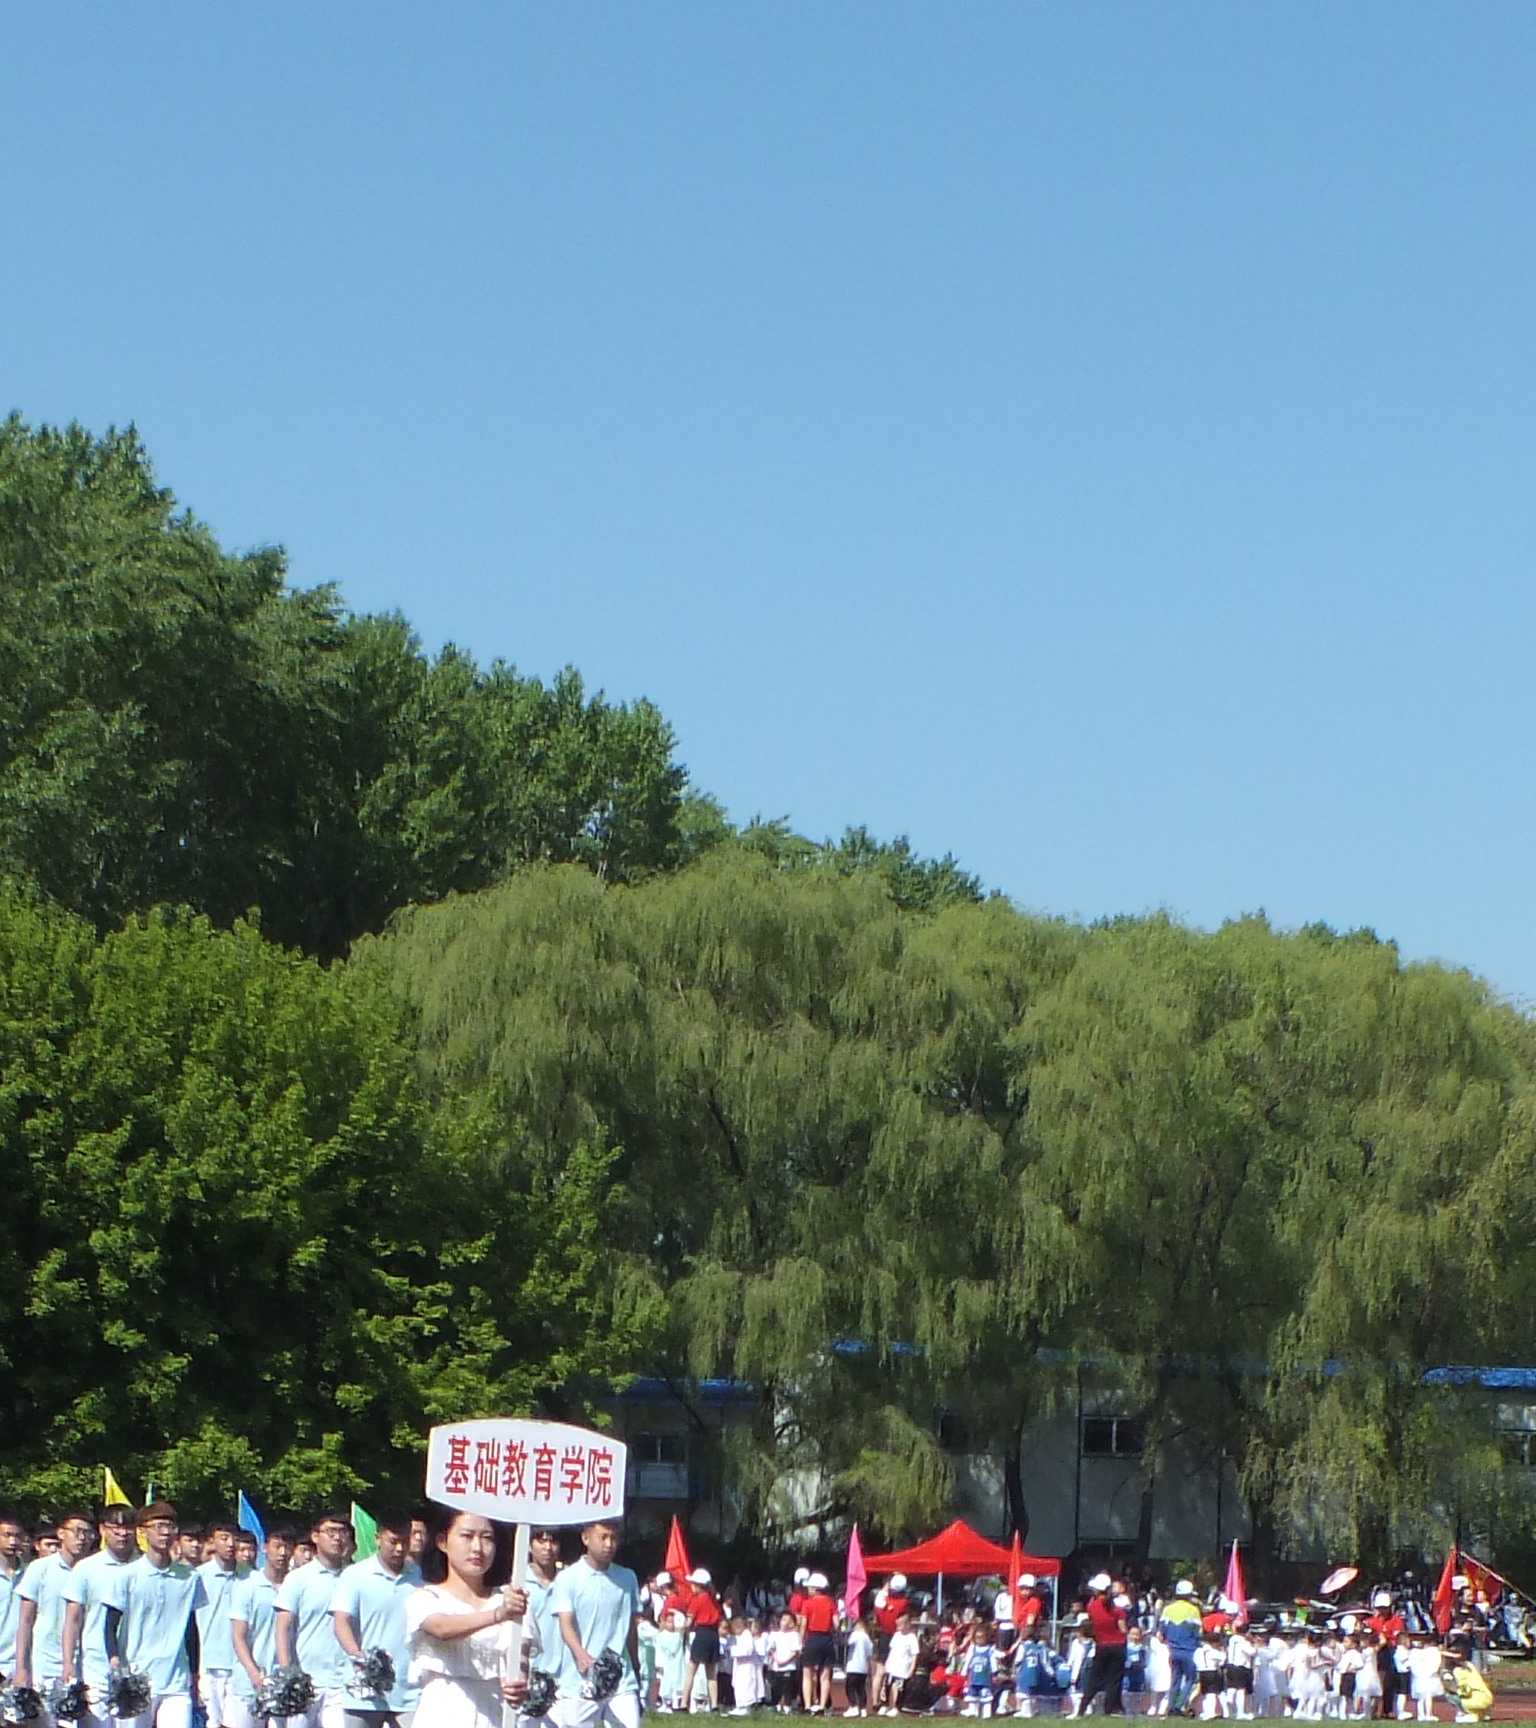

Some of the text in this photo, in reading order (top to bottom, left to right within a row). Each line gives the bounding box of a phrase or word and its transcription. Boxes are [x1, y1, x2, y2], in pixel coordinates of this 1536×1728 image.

[443, 1434, 614, 1507] 基础教育学院
